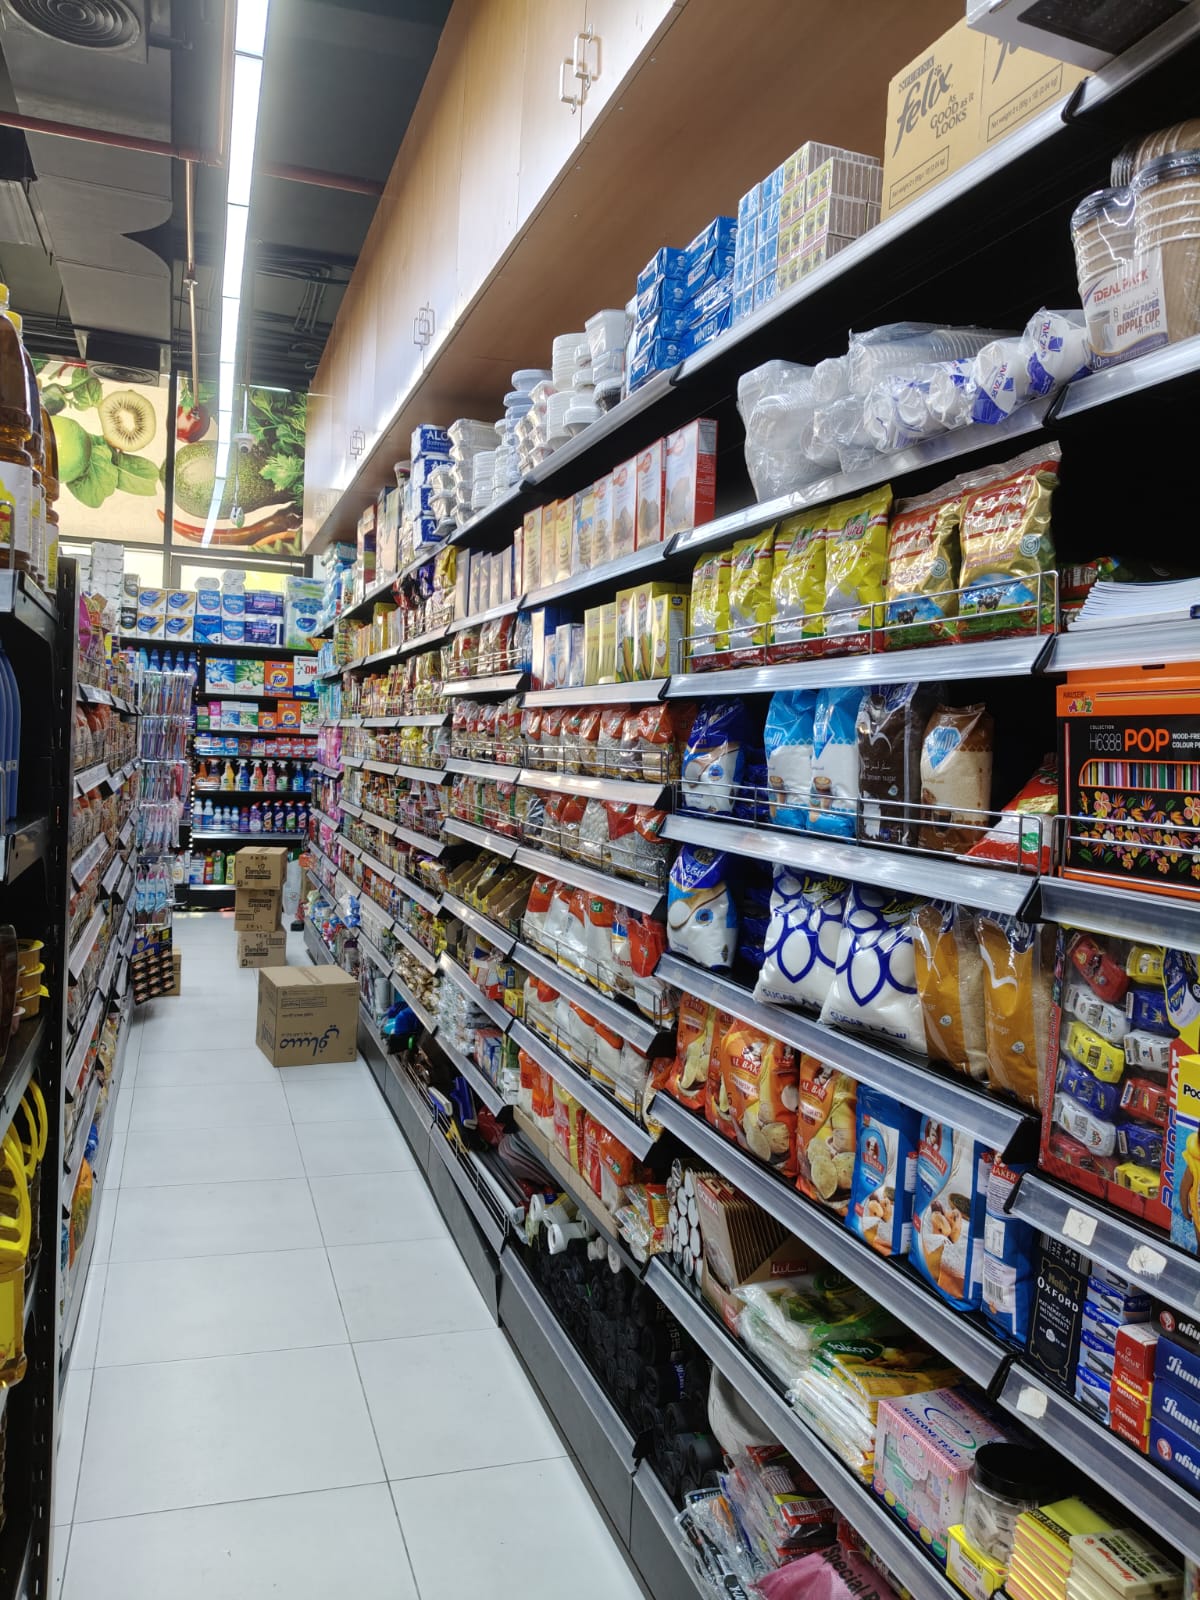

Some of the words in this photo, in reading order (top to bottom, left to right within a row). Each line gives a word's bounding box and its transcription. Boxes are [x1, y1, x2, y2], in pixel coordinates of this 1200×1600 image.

[930, 102, 958, 130] GOOD
[935, 108, 967, 139] LOOKS
[1093, 282, 1121, 303] IDEAL
[1122, 268, 1149, 290] PACK
[1116, 315, 1143, 336] RIPPLE
[1144, 308, 1160, 323] CUP
[1122, 309, 1140, 321] KRAFT
[1140, 298, 1160, 313] PAPER
[1089, 733, 1122, 752] H6388
[1124, 727, 1170, 753] POP
[1172, 741, 1194, 749] COLOUR
[803, 875, 846, 893] Lucky
[763, 988, 796, 1002] SUGAR
[830, 1010, 863, 1027] SUGAR
[280, 1024, 339, 1056] مسافي
[1037, 1276, 1079, 1313] OXFORD
[1039, 1298, 1072, 1326] MATHEMATICAL
[1039, 1306, 1070, 1331] INSTRUMENTS
[827, 1341, 875, 1355] falcon
[902, 1407, 940, 1439] SILICONE
[938, 1439, 961, 1459] TEAT
[822, 1545, 867, 1597] Special
